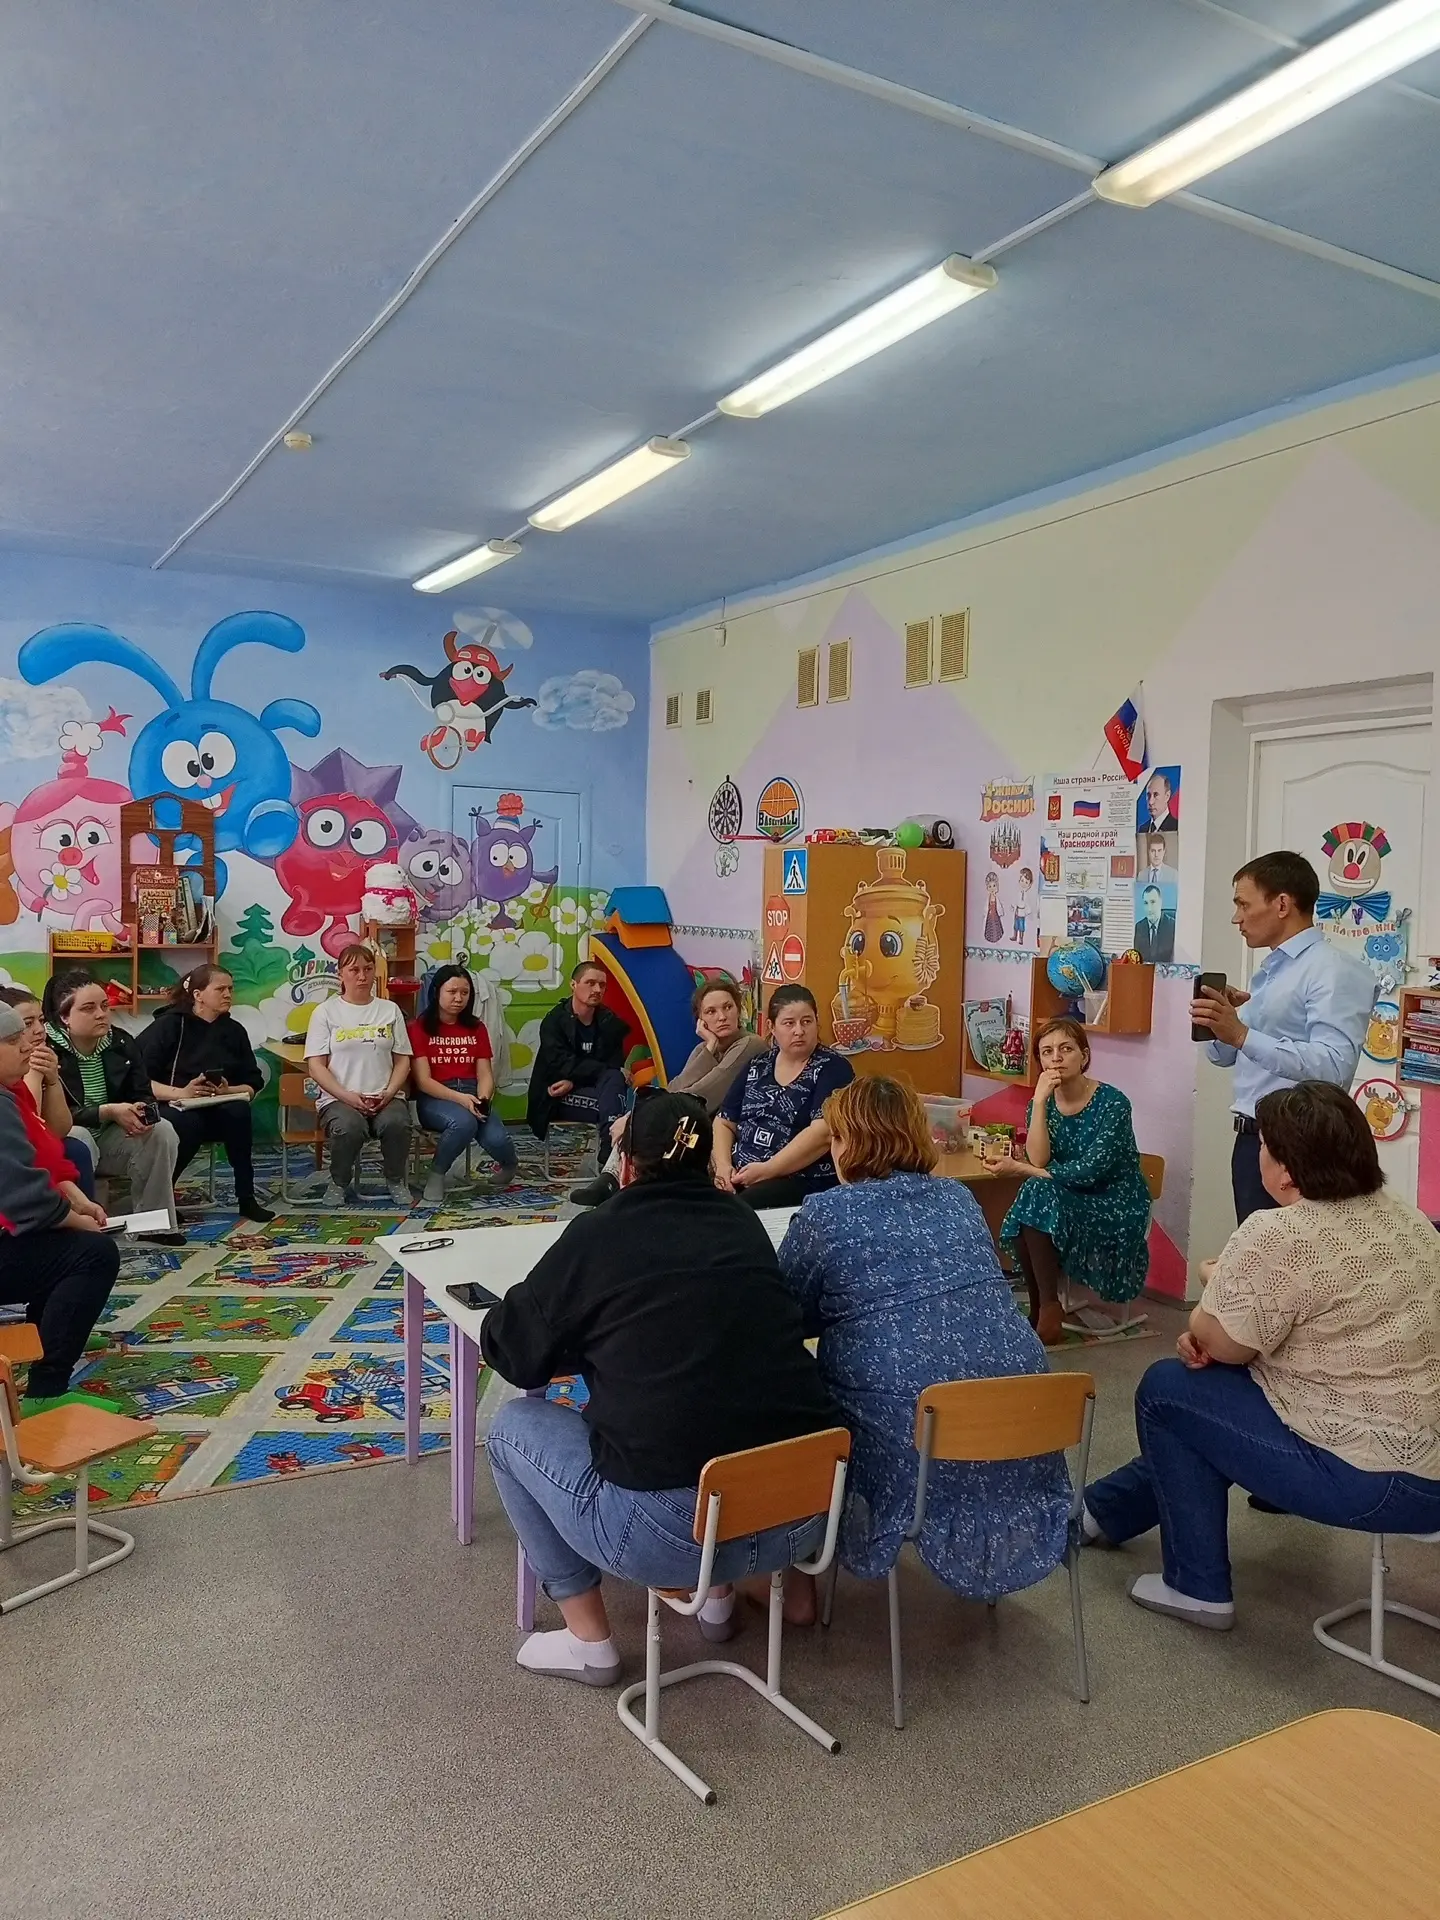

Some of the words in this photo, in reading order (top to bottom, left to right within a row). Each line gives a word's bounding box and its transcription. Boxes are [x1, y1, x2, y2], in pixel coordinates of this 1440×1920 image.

[1071, 775, 1096, 785] страна
[758, 811, 798, 826] BASKETBALL
[1072, 830, 1100, 839] родной
[1101, 829, 1118, 839] край
[1060, 838, 1115, 849] Красноярский
[767, 910, 788, 926] STOP
[438, 1047, 468, 1055] 1892
[431, 1056, 451, 1064] NEW
